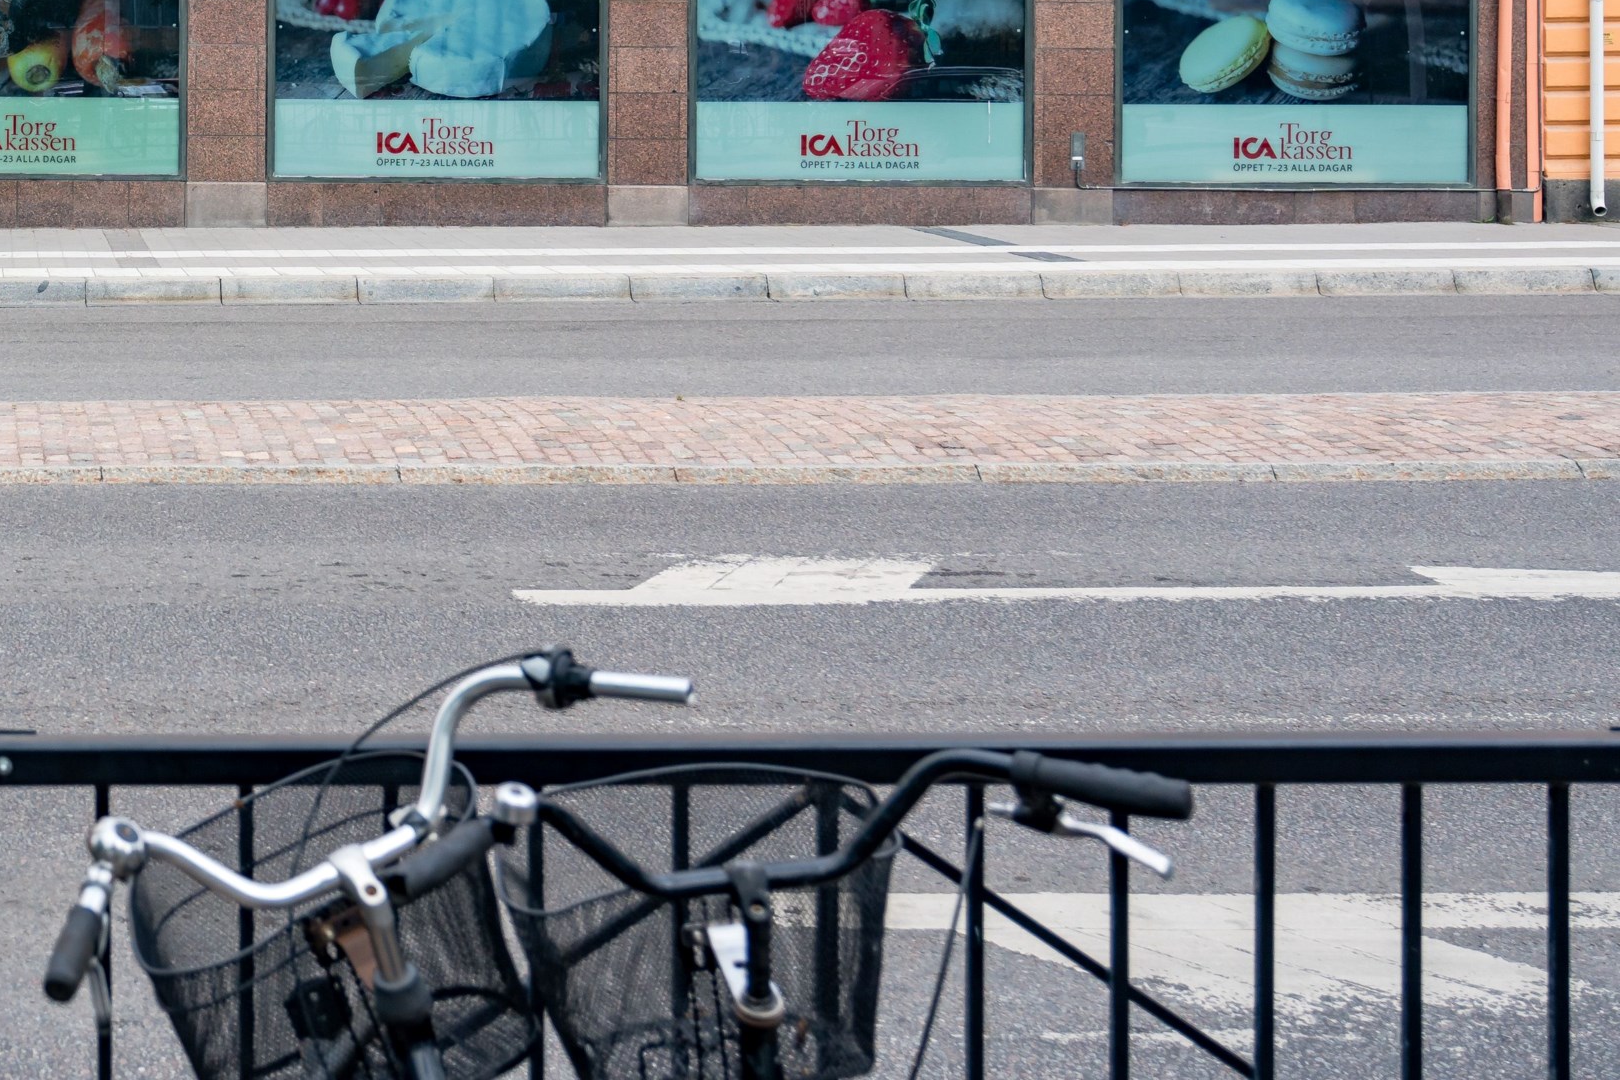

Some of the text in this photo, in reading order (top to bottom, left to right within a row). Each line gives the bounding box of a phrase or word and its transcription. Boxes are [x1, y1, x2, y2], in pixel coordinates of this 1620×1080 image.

[6, 115, 57, 139] Torg
[423, 118, 474, 142] Torg
[847, 120, 899, 144] Torg
[1280, 123, 1332, 147] Torg
[5, 129, 76, 151] kassen
[377, 132, 419, 153] ICA
[422, 133, 494, 154] kassen
[801, 134, 844, 156] ICA
[846, 135, 919, 156] kassen
[1234, 137, 1277, 159] ICA
[1280, 138, 1352, 160] kassen
[16, 155, 40, 163] ALLA
[43, 155, 76, 163] DAGAR
[377, 157, 407, 166] ÖPPET
[800, 160, 831, 168] ÖPPET
[1233, 163, 1264, 171] ÖPPET
